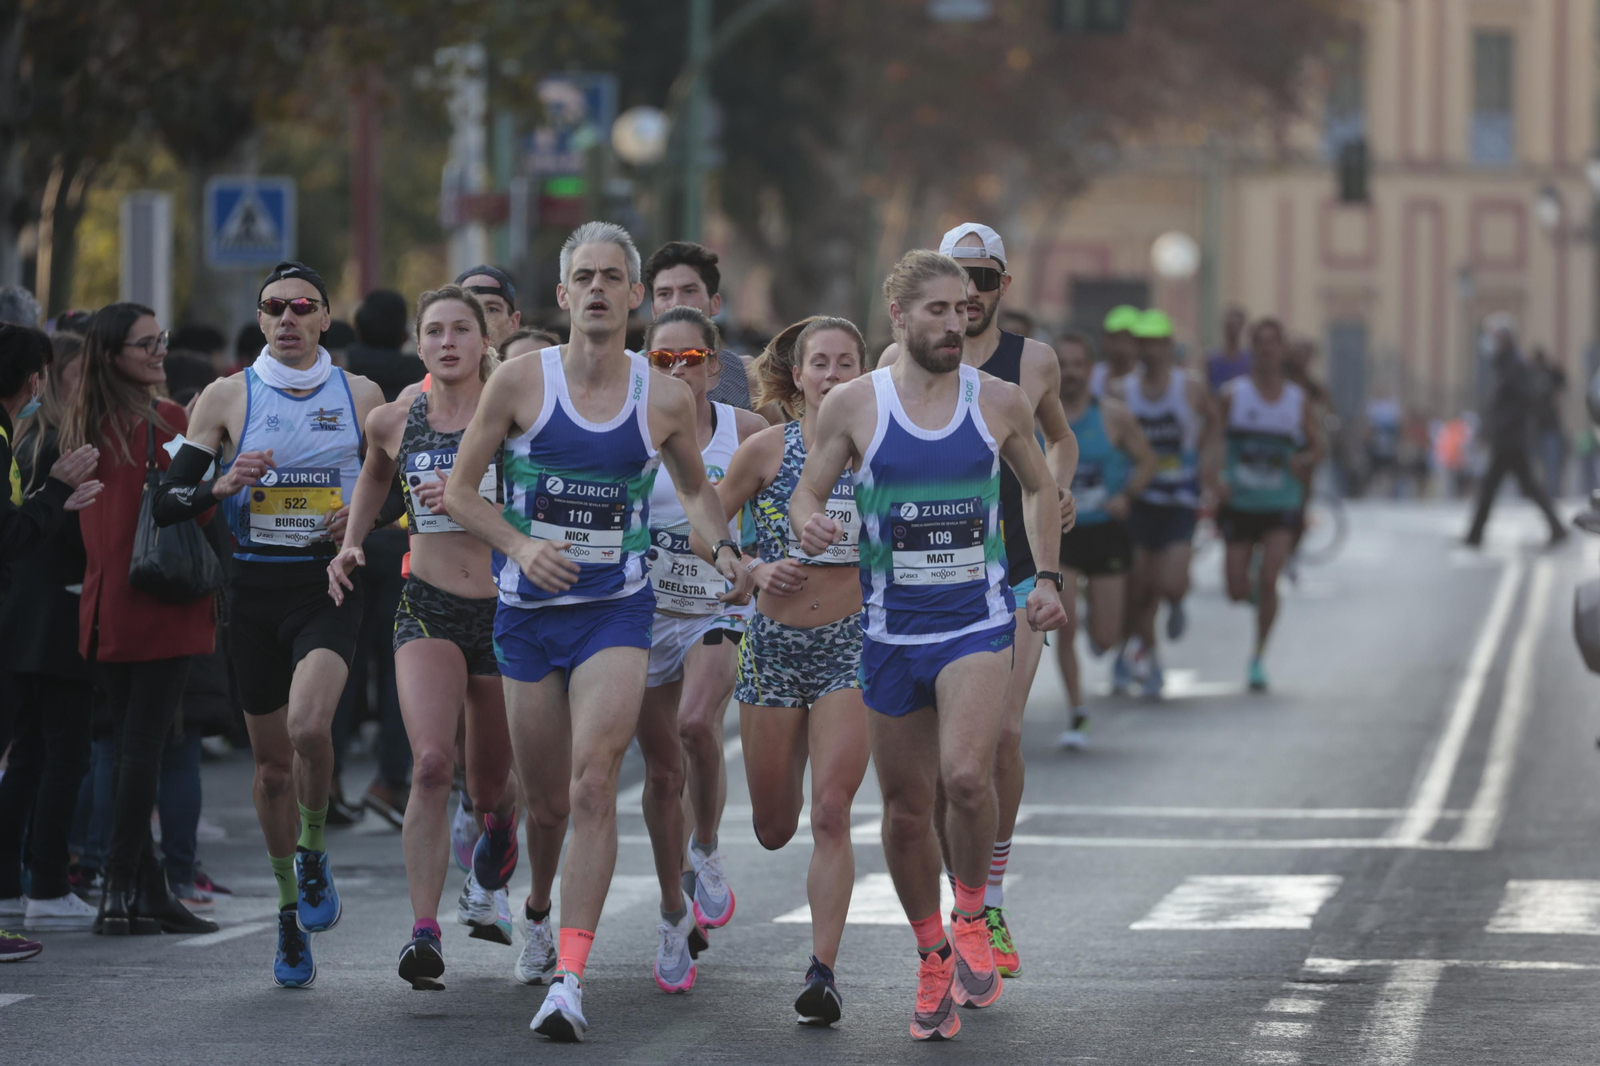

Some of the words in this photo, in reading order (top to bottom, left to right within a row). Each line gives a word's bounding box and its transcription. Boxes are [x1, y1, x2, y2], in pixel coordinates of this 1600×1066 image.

[632, 373, 643, 402] soar
[964, 379, 974, 404] soar
[319, 422, 337, 432] Viso
[280, 472, 330, 484] ZURICH
[566, 483, 619, 498] ZURICH
[284, 497, 307, 510] 522
[921, 503, 974, 517] ZURICH
[275, 517, 316, 528] BURGOS
[568, 509, 593, 525] 110
[564, 530, 590, 543] NICK
[927, 530, 952, 545] 109
[926, 553, 955, 564] MATT
[671, 562, 698, 577] F215
[658, 578, 707, 596] DEELSTRA
